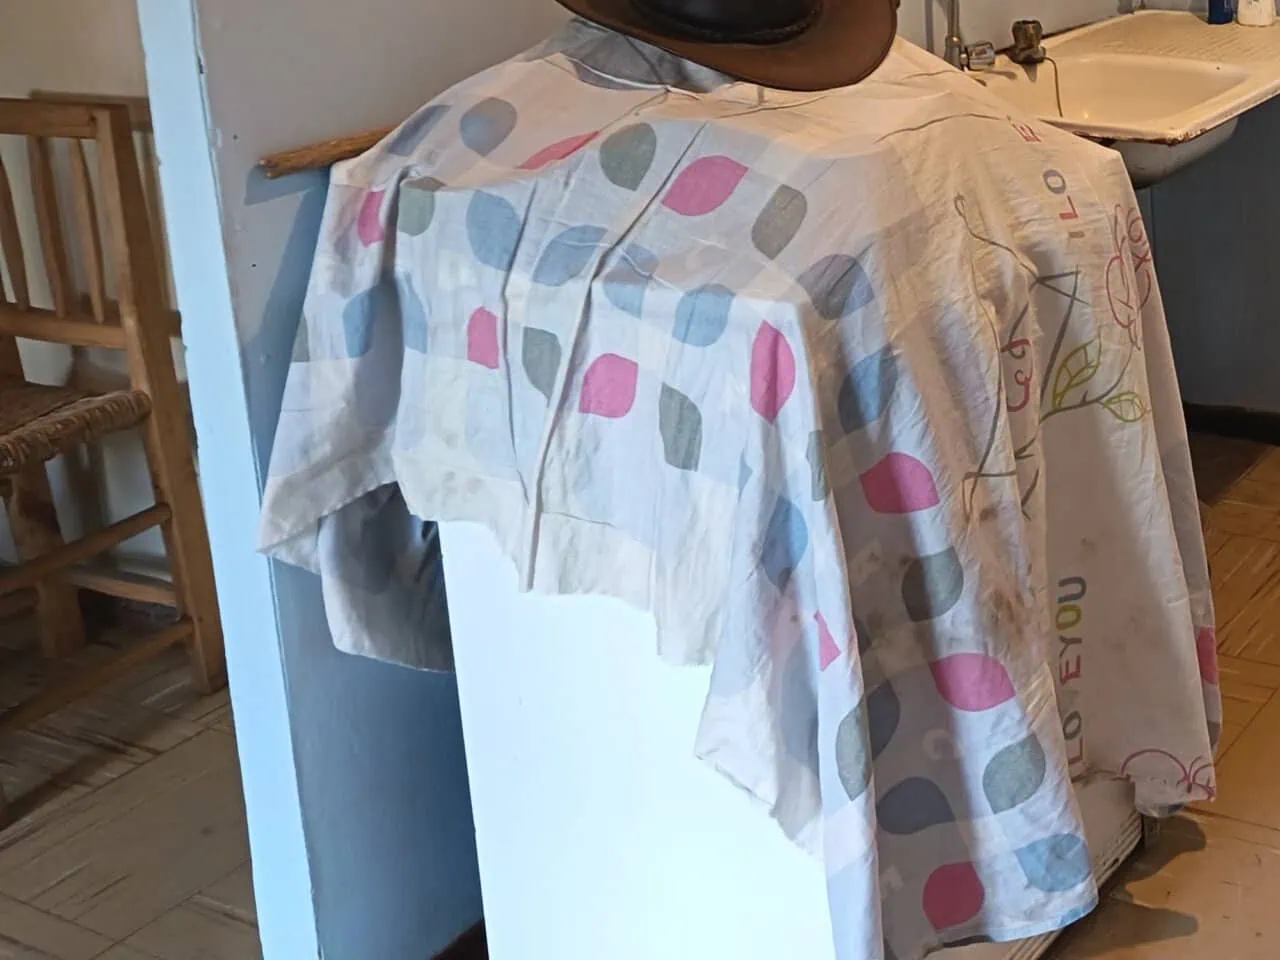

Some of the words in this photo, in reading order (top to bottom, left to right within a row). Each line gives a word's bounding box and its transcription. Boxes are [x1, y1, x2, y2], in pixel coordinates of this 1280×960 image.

[1011, 122, 1079, 220] LOE
[1055, 576, 1088, 657] YOU
[1059, 654, 1084, 765] LOE
